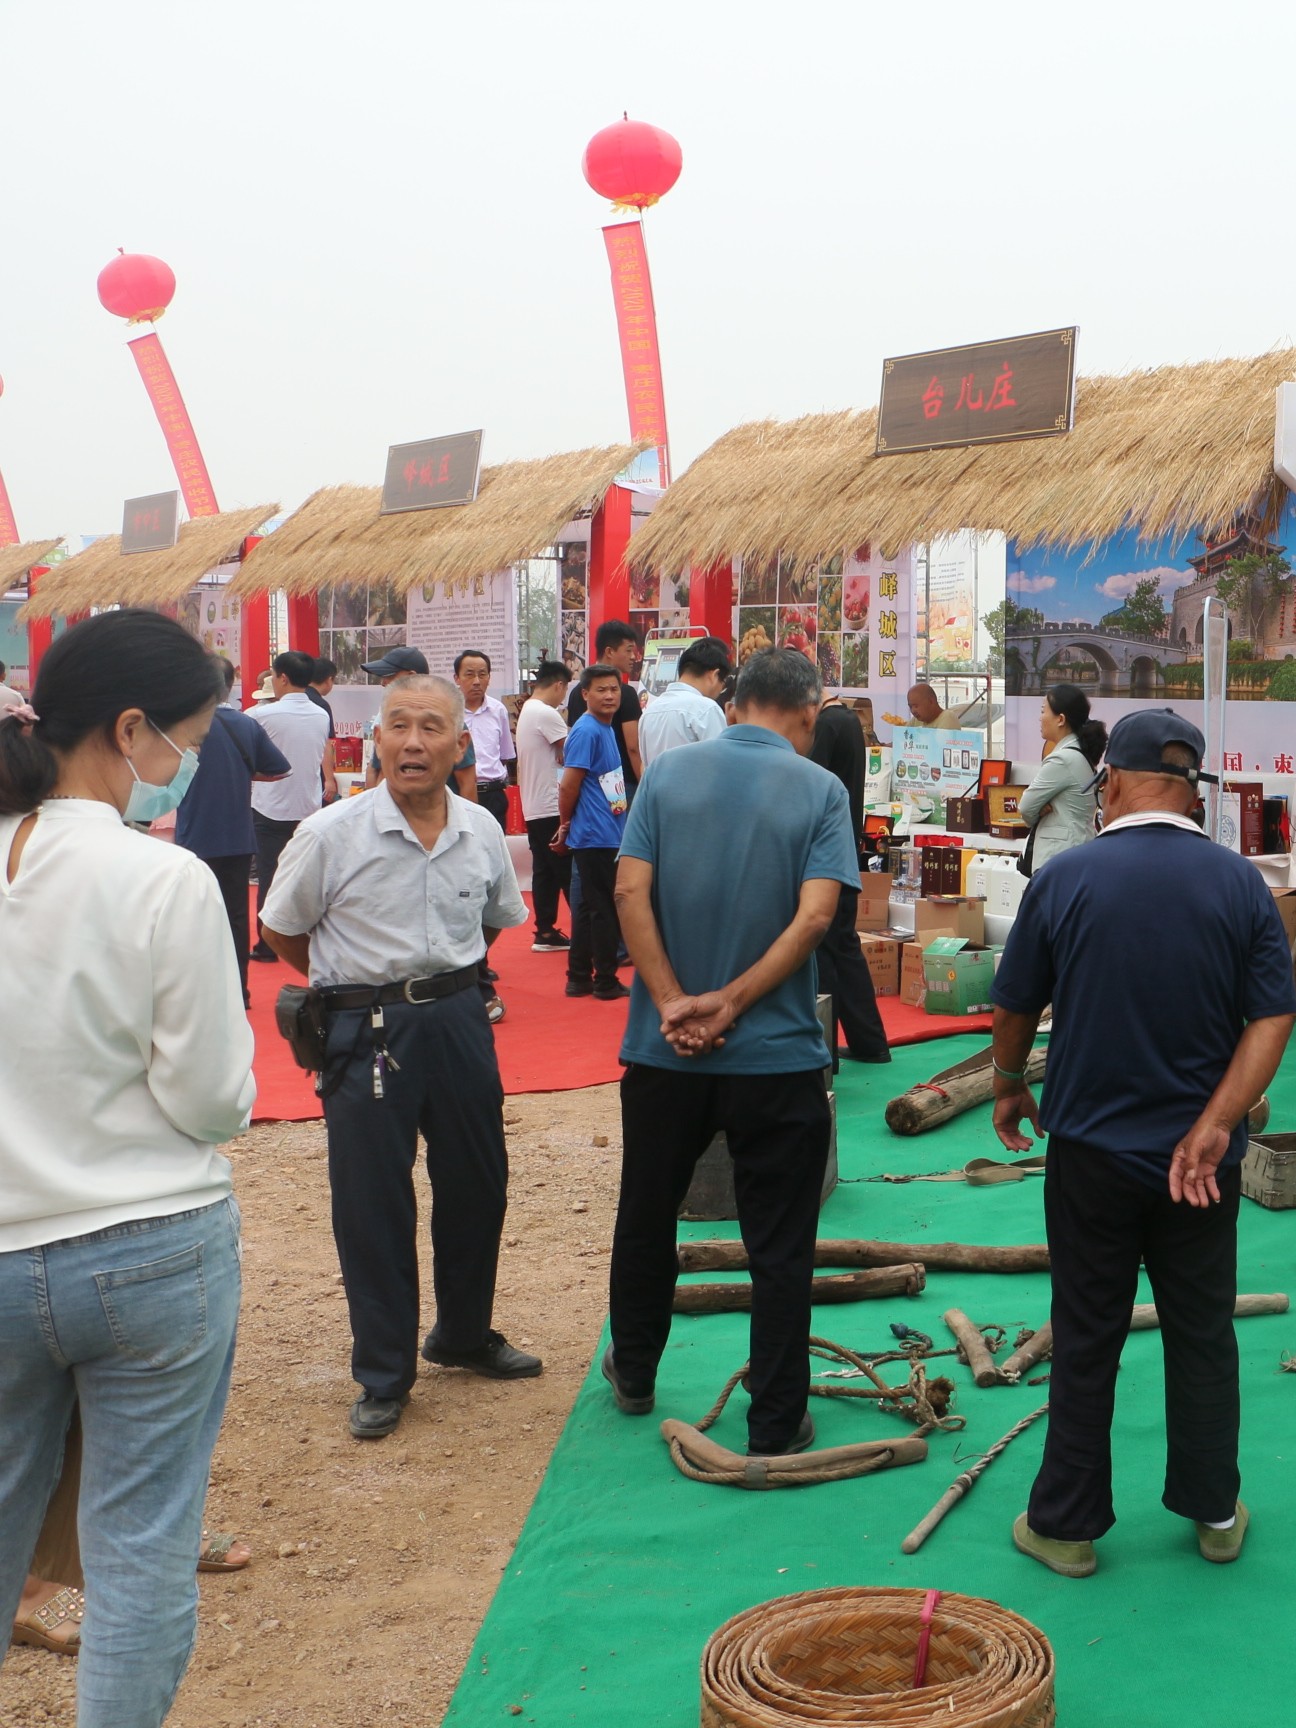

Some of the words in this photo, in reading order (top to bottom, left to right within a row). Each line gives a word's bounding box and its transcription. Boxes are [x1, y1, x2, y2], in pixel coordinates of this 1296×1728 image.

[922, 361, 1017, 420] 台儿庄
[879, 572, 898, 677] 峄城区
